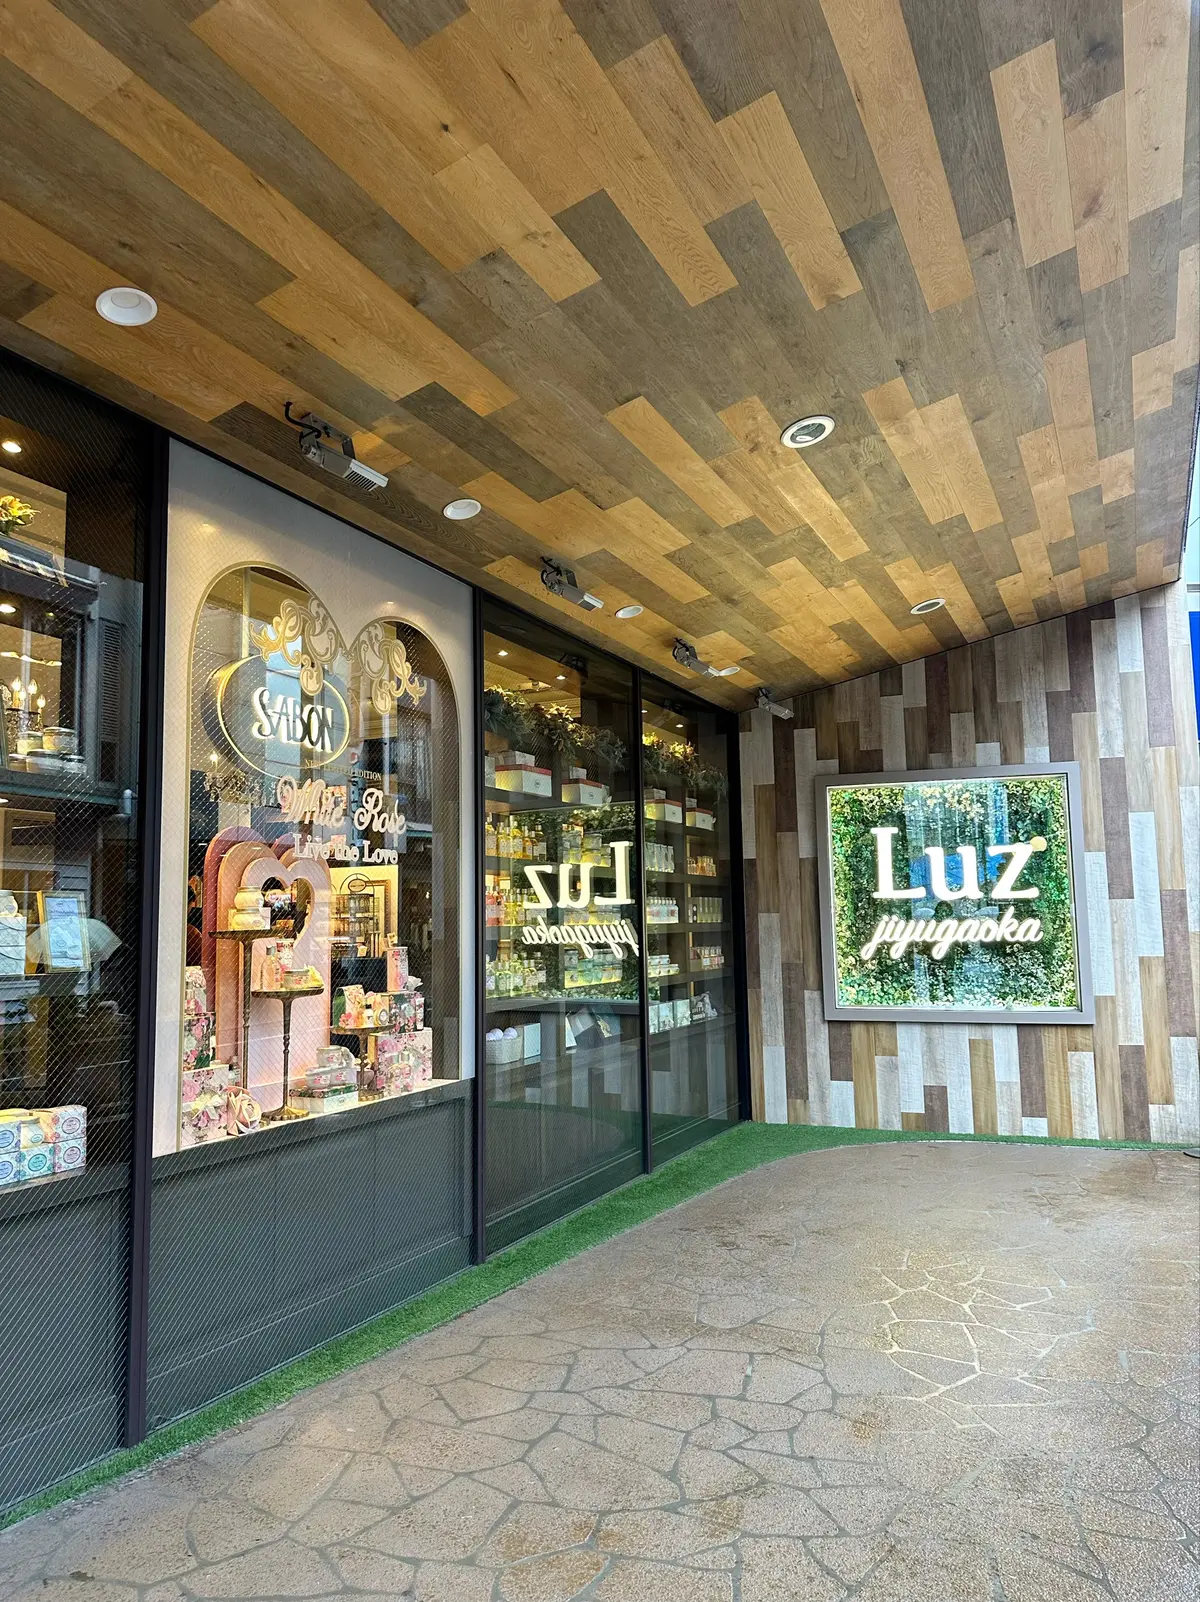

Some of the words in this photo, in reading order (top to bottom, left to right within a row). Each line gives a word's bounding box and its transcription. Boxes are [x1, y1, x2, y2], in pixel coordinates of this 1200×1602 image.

[252, 687, 333, 752] SABON
[277, 775, 344, 828] White
[354, 788, 406, 834] Rose
[292, 833, 330, 861] Live
[334, 840, 359, 862] the
[363, 840, 398, 865] Love
[871, 827, 1040, 900] Luz
[861, 906, 1043, 960] jiyugaoka
